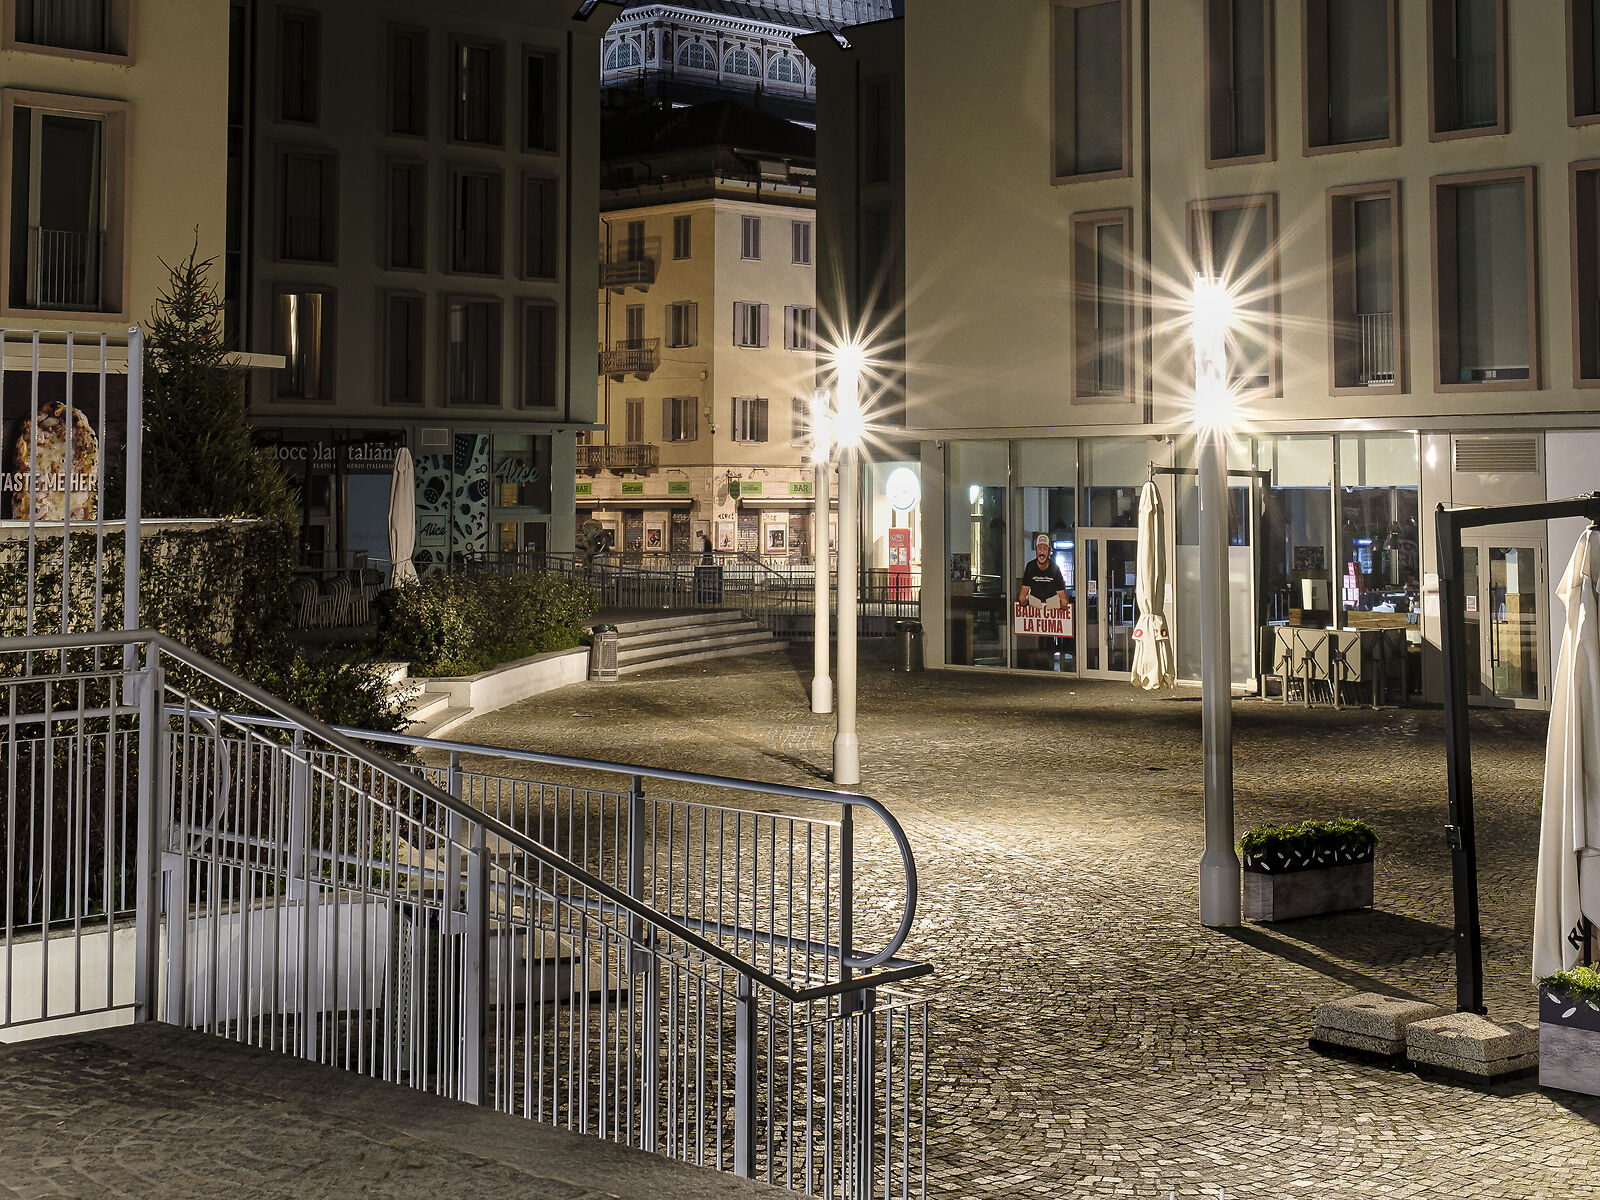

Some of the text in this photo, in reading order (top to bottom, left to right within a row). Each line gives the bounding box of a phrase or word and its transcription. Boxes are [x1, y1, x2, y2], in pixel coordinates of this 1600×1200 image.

[492, 457, 541, 484] Alice
[45, 472, 66, 492] ME
[793, 484, 809, 492] BAR
[418, 522, 448, 537] Alice
[1015, 604, 1042, 618] BADA
[1023, 618, 1063, 634] LA FUMA
